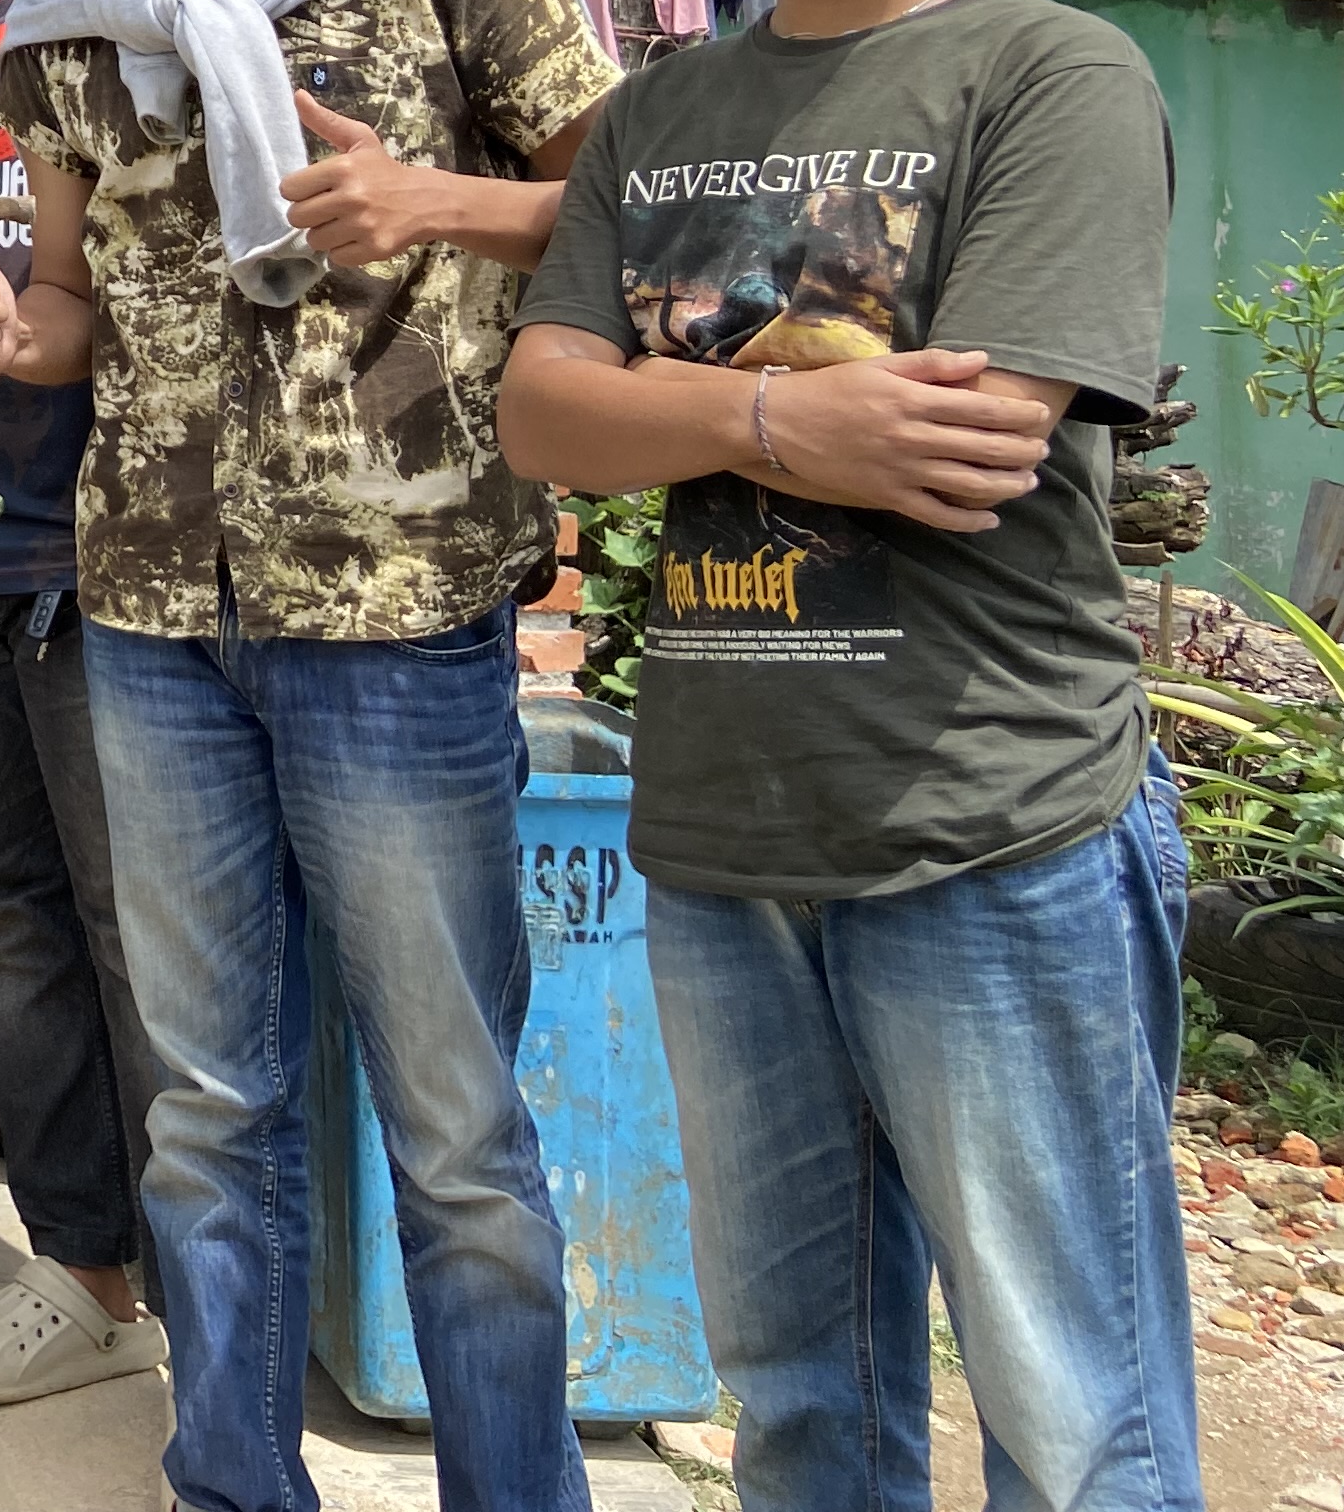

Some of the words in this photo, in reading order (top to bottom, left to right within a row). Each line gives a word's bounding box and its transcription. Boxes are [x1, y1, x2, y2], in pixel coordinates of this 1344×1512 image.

[622, 161, 756, 205] NEVER
[758, 150, 857, 193] GIVE
[863, 149, 936, 190] UP
[812, 629, 831, 639] FOR
[832, 629, 852, 639] THE
[852, 628, 904, 639] WARRIORS
[791, 652, 819, 661] THEIR
[819, 652, 854, 661] FAMILY
